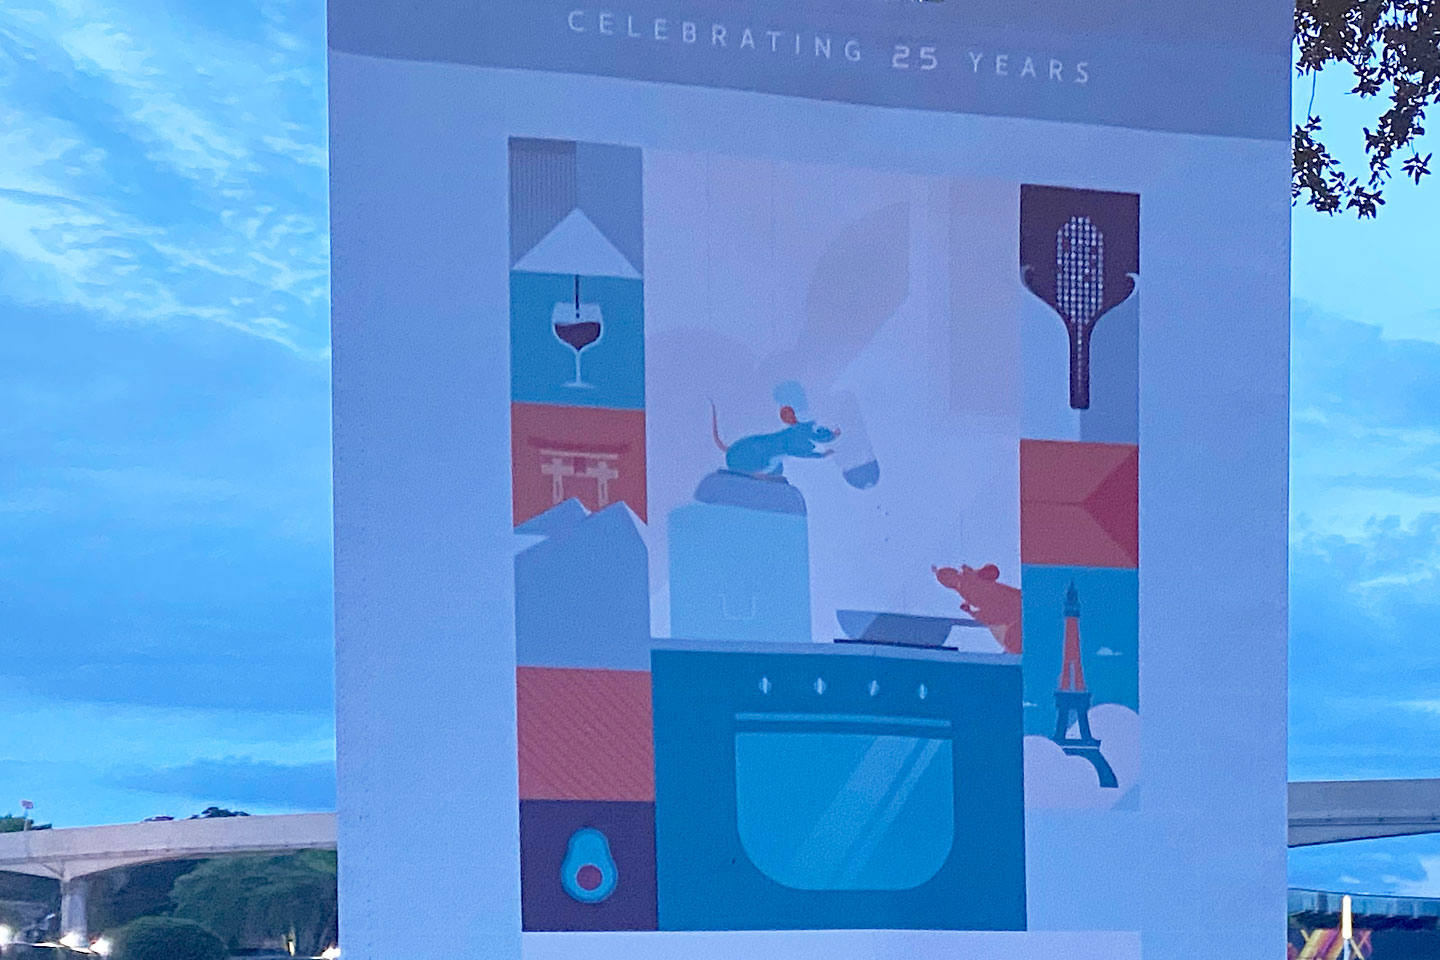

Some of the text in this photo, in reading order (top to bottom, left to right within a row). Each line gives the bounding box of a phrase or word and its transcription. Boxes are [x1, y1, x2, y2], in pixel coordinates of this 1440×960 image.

[567, 10, 1089, 84] CELEBRATING 25 YEARS
